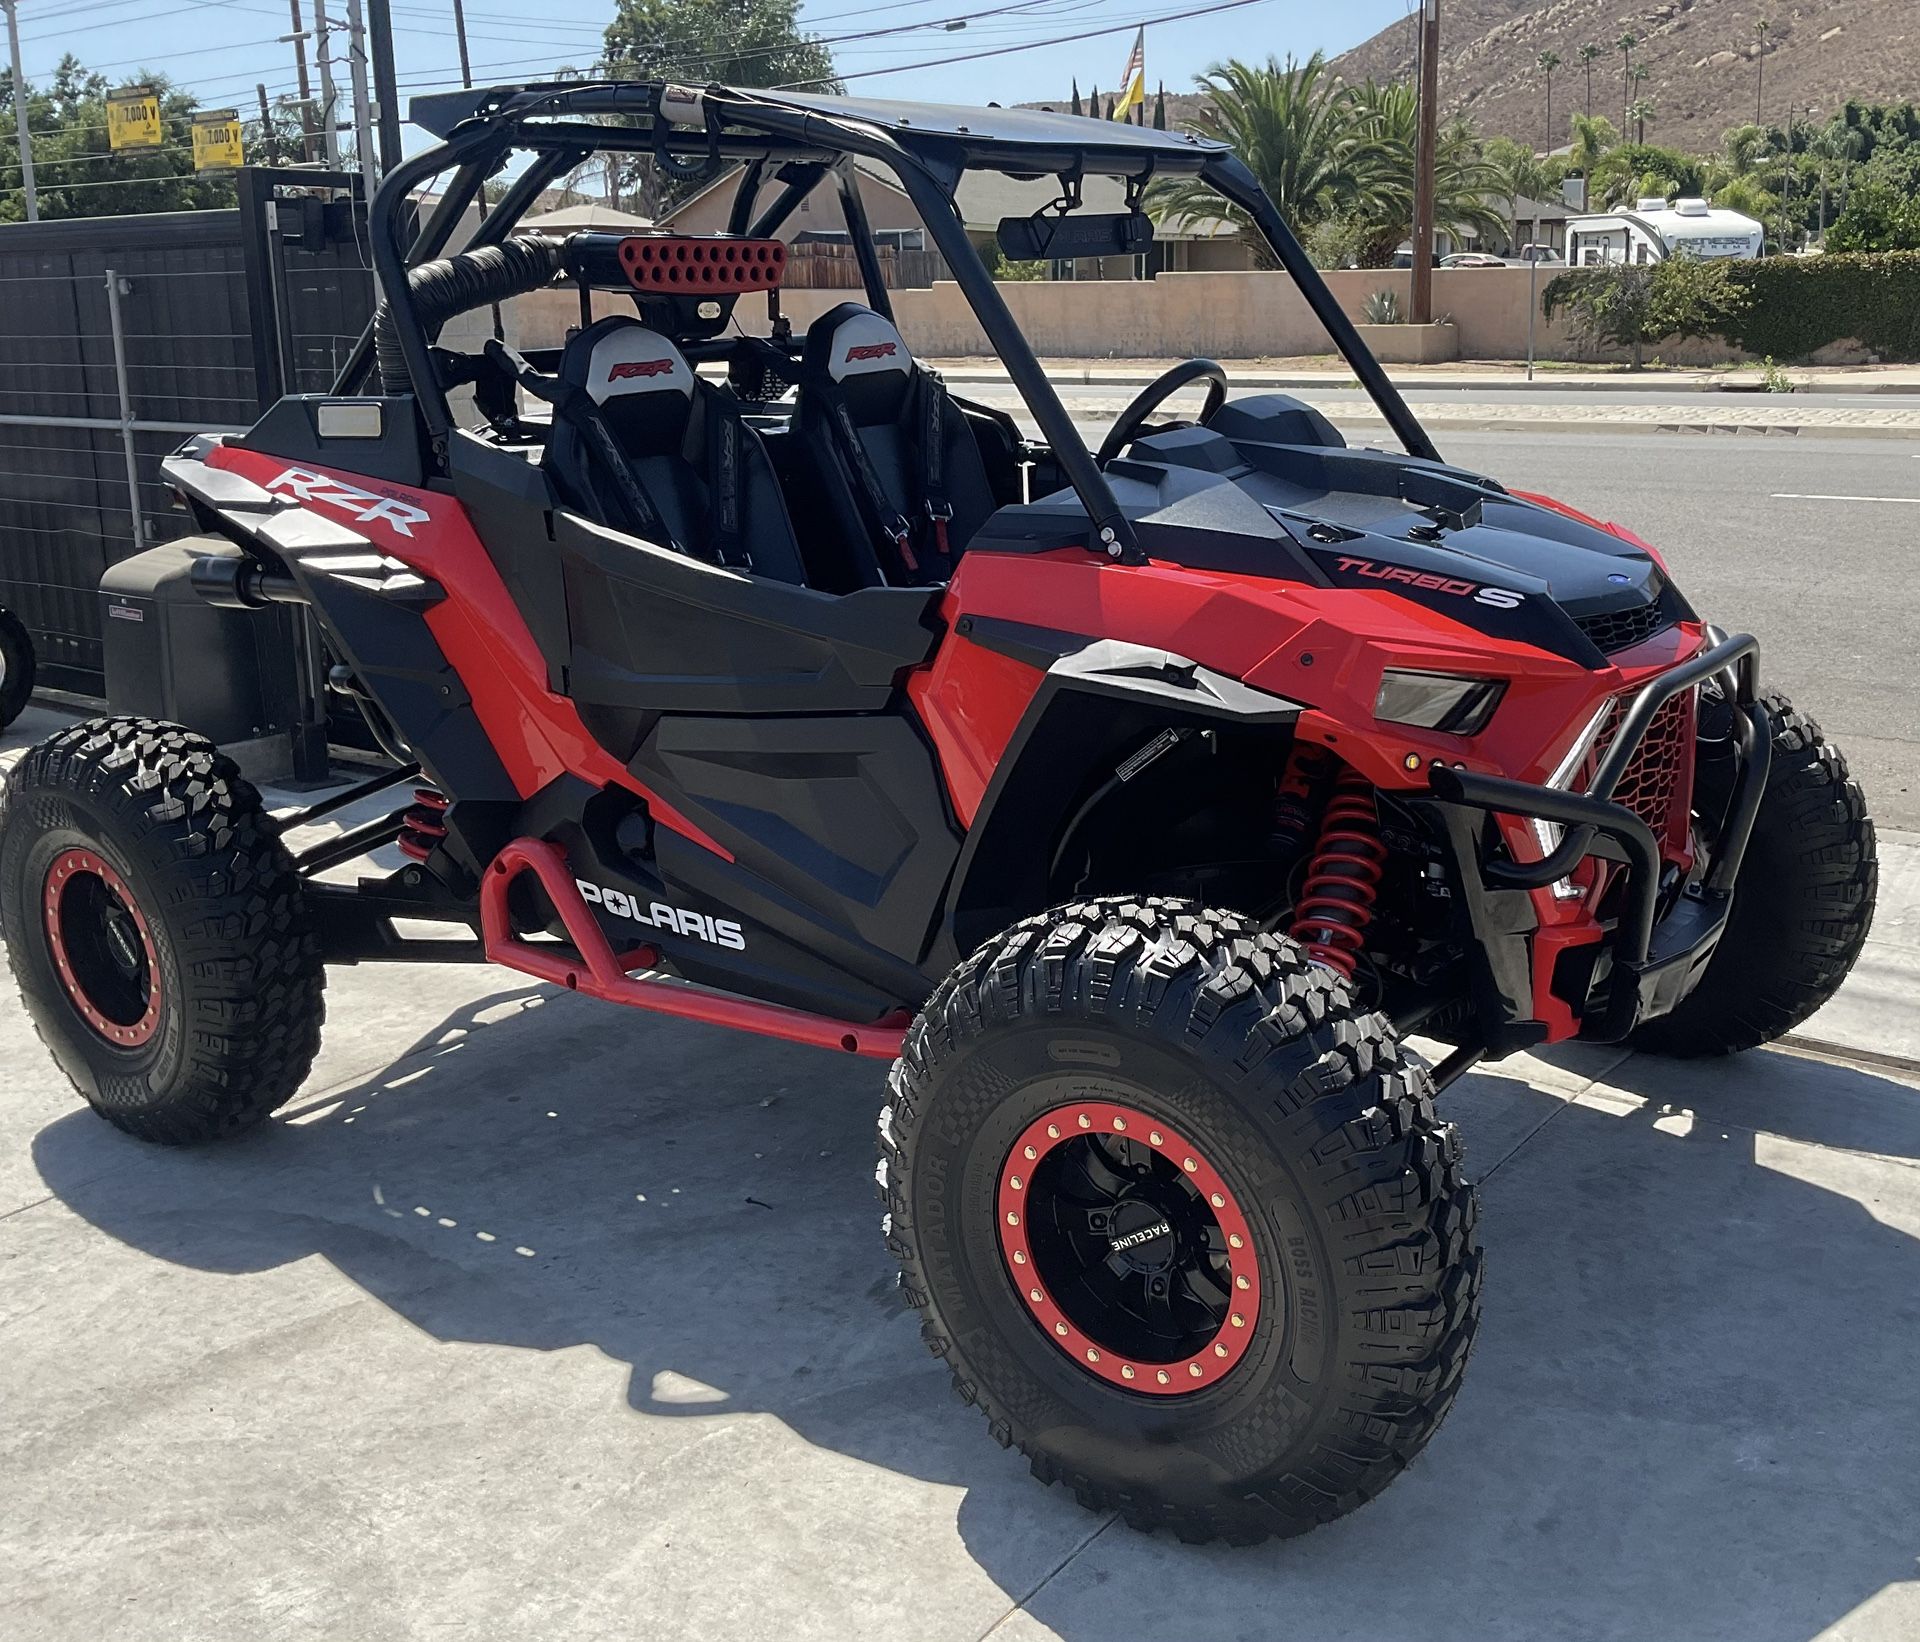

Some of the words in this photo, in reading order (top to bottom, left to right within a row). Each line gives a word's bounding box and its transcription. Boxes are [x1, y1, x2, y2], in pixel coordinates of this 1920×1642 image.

[150, 106, 156, 120] V
[232, 129, 238, 143] V
[846, 342, 896, 363] RZR
[608, 358, 674, 382] RZR
[265, 466, 431, 538] RZR
[1335, 556, 1477, 596] TURBO
[1474, 587, 1525, 609] S
[575, 878, 746, 951] POLARIS
[924, 1152, 967, 1312] MATADOR
[1111, 1223, 1170, 1251] RACELINE
